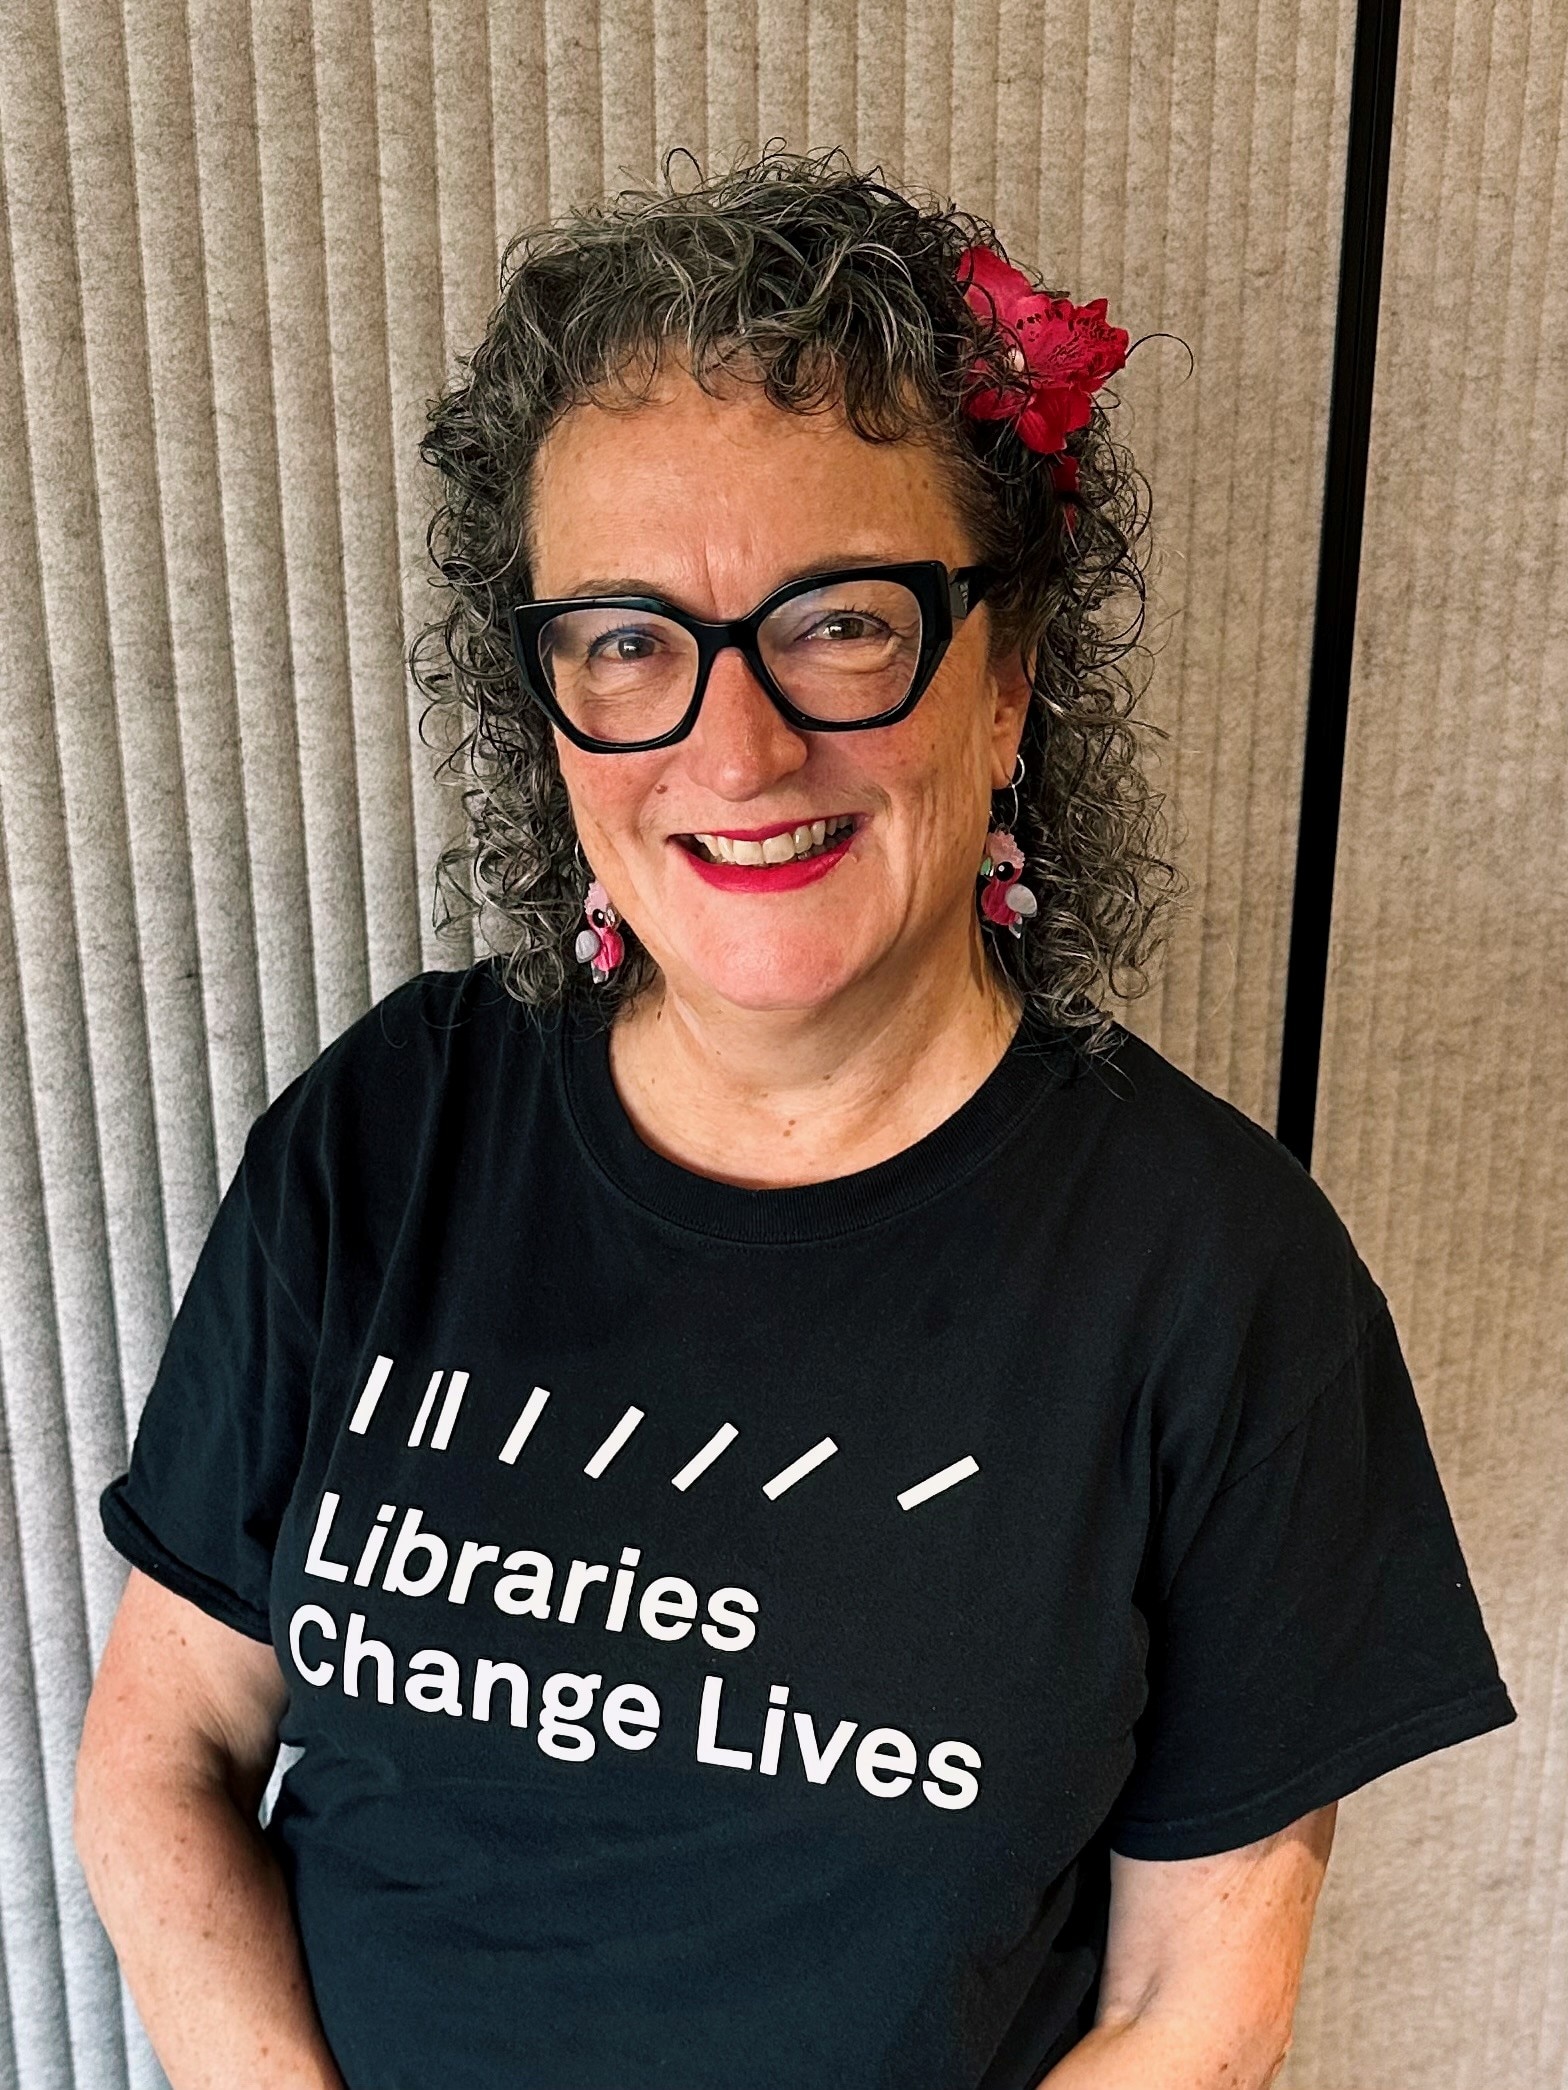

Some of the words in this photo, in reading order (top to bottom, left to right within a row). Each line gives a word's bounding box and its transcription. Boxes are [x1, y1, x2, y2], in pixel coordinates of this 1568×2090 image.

[304, 1491, 759, 1652] Libraries
[288, 1604, 661, 1762] Change
[696, 1675, 982, 1810] Lives
